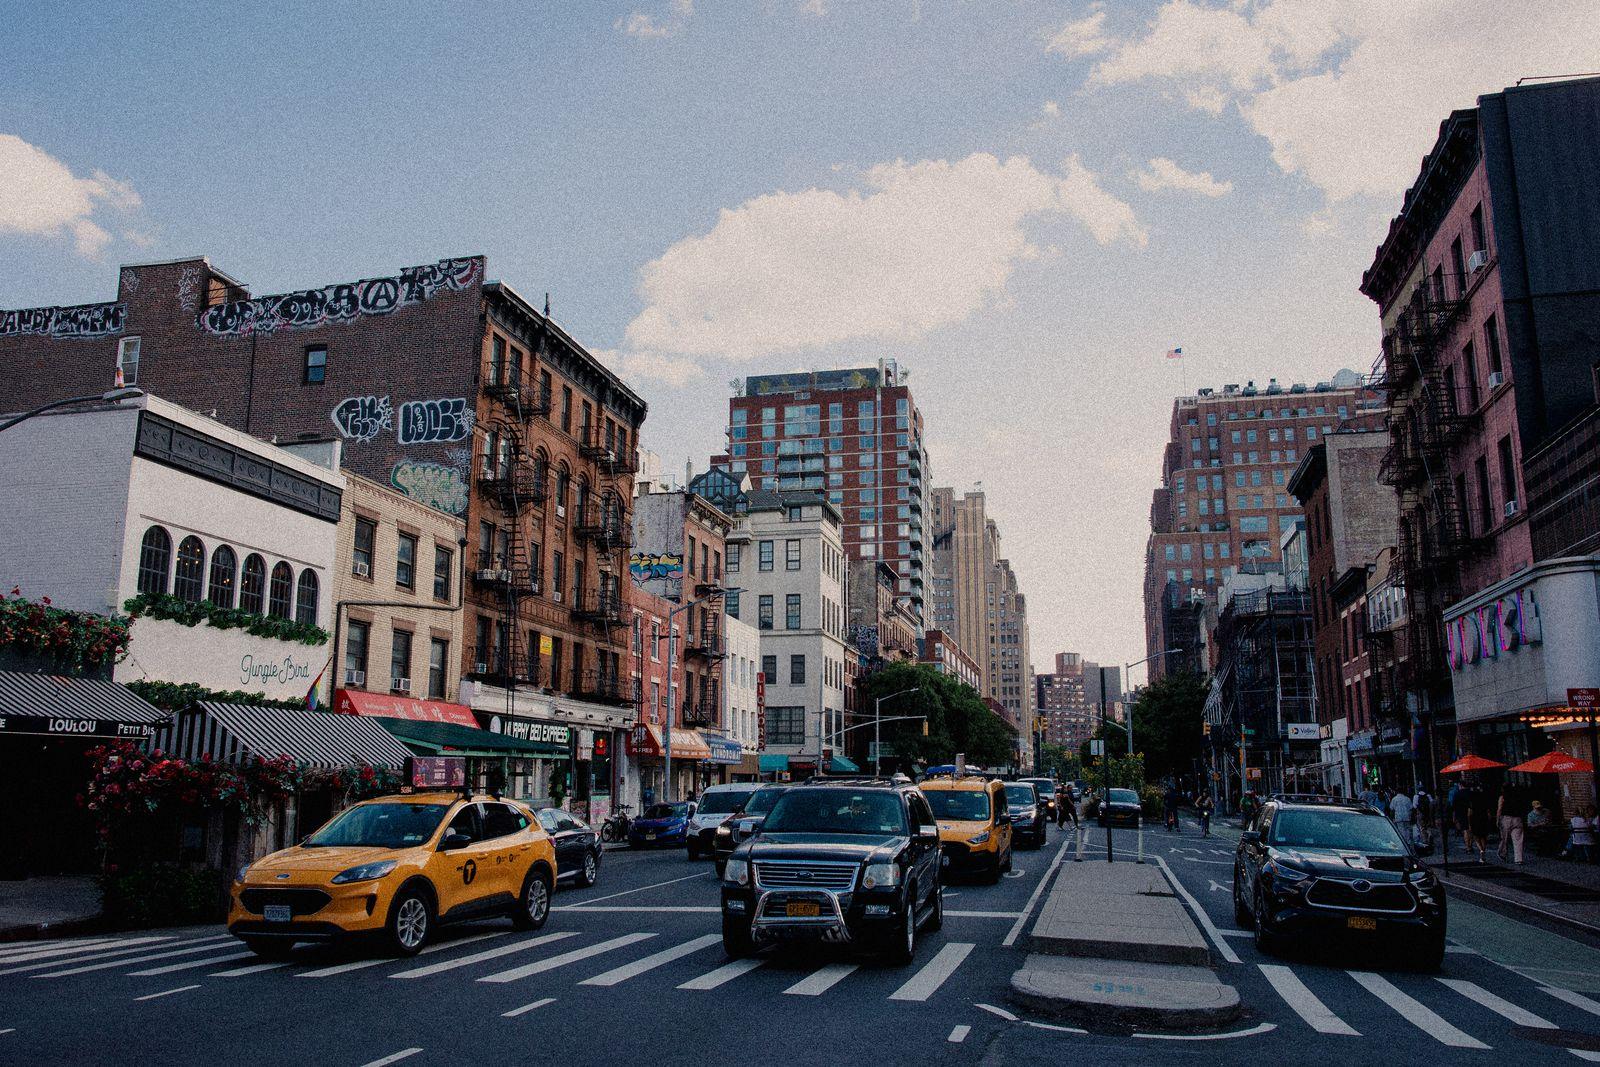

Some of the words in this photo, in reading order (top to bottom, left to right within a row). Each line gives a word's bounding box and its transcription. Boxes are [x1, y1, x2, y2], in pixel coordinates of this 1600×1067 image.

[240, 654, 278, 685] Jungle
[278, 654, 310, 684] Bird
[48, 718, 97, 733] LOULOU
[117, 723, 141, 735] PETIT
[529, 723, 542, 741] BED
[542, 724, 569, 743] EXPRESS
